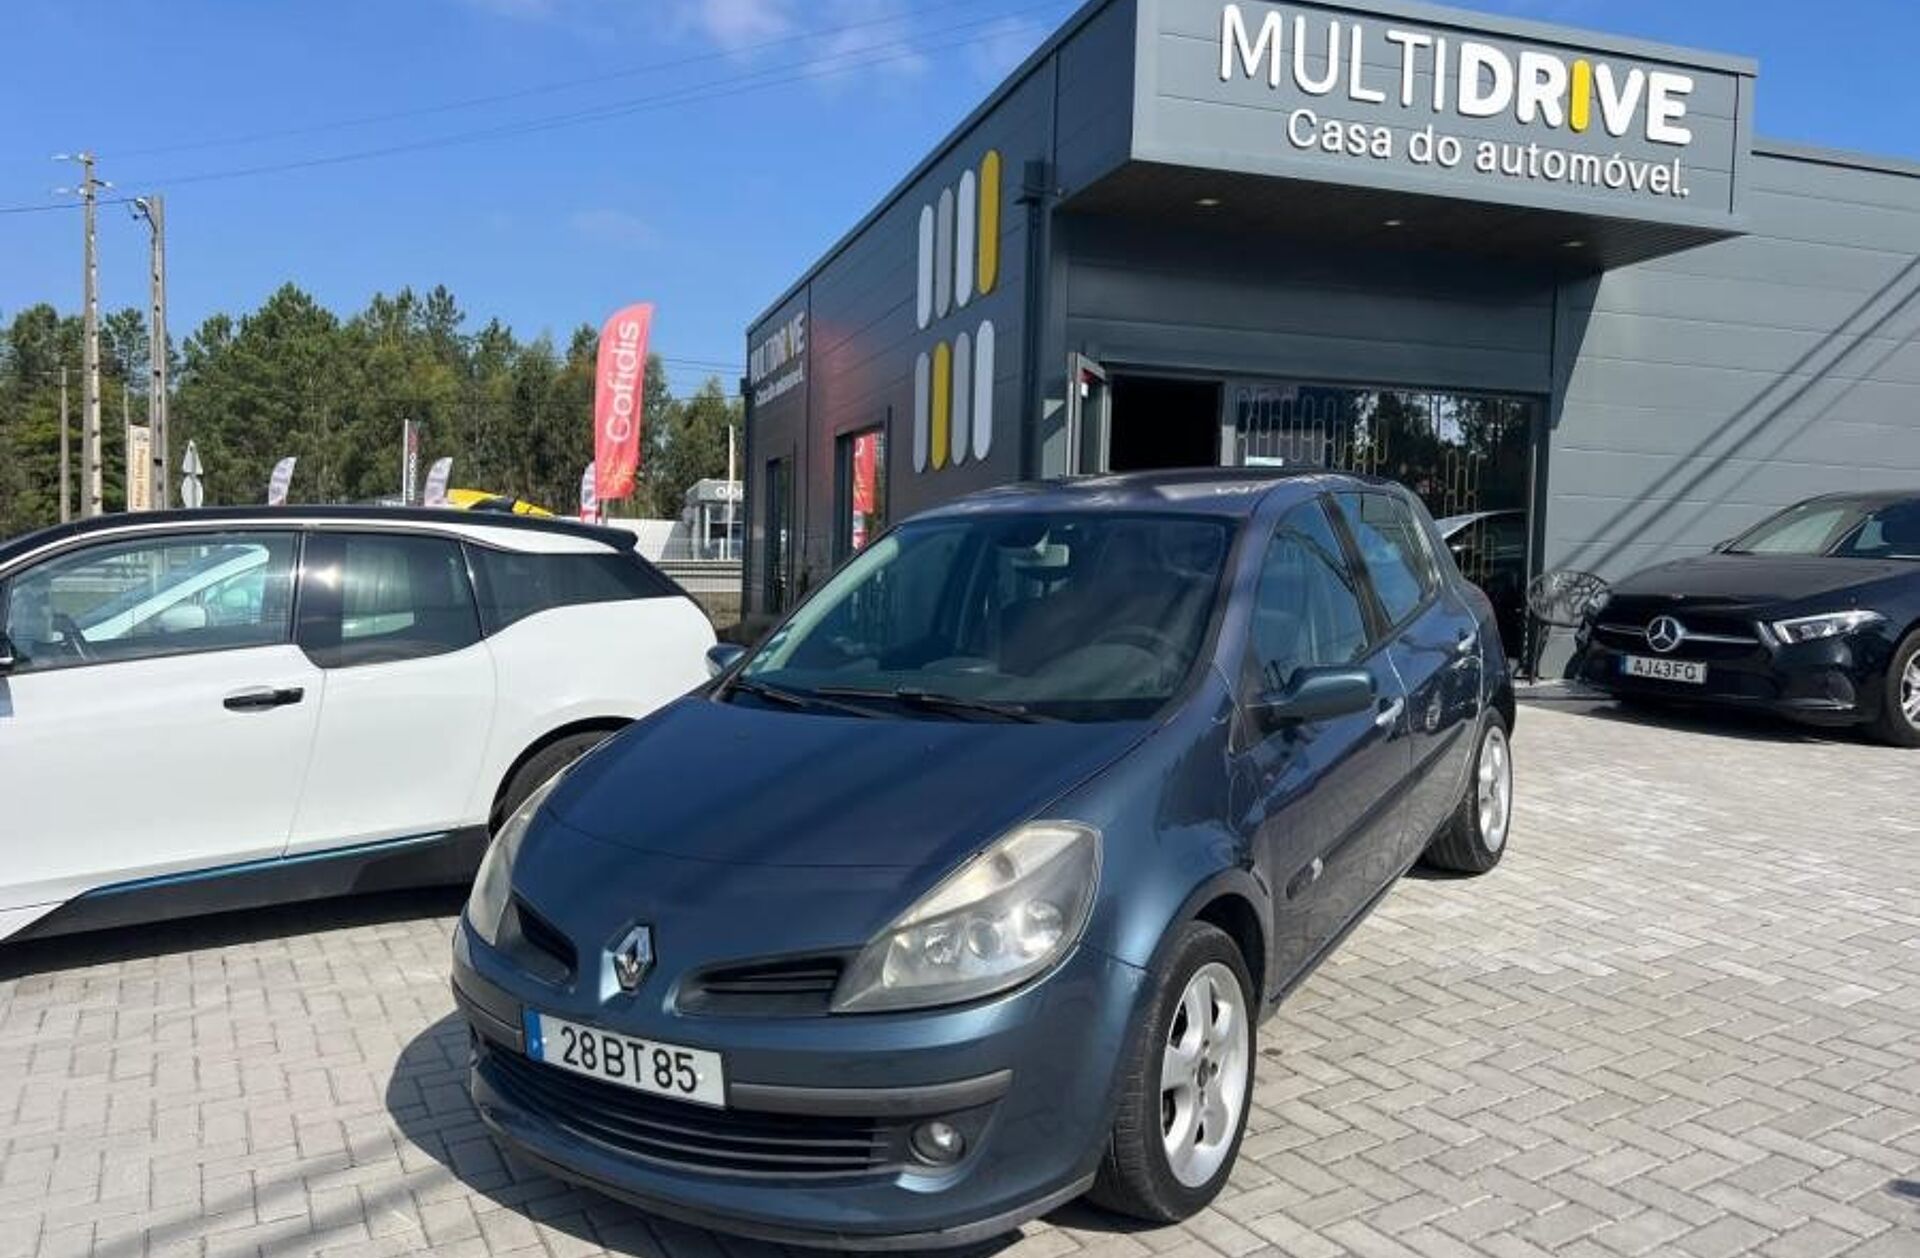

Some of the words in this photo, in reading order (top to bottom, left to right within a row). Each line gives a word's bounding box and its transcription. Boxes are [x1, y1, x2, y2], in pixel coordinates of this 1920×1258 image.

[1219, 3, 1693, 146] MULTIDRIVE
[1287, 108, 1393, 160] Casa
[1408, 124, 1462, 167] do
[1475, 140, 1691, 198] automóvel.
[606, 319, 641, 443] Cofidis
